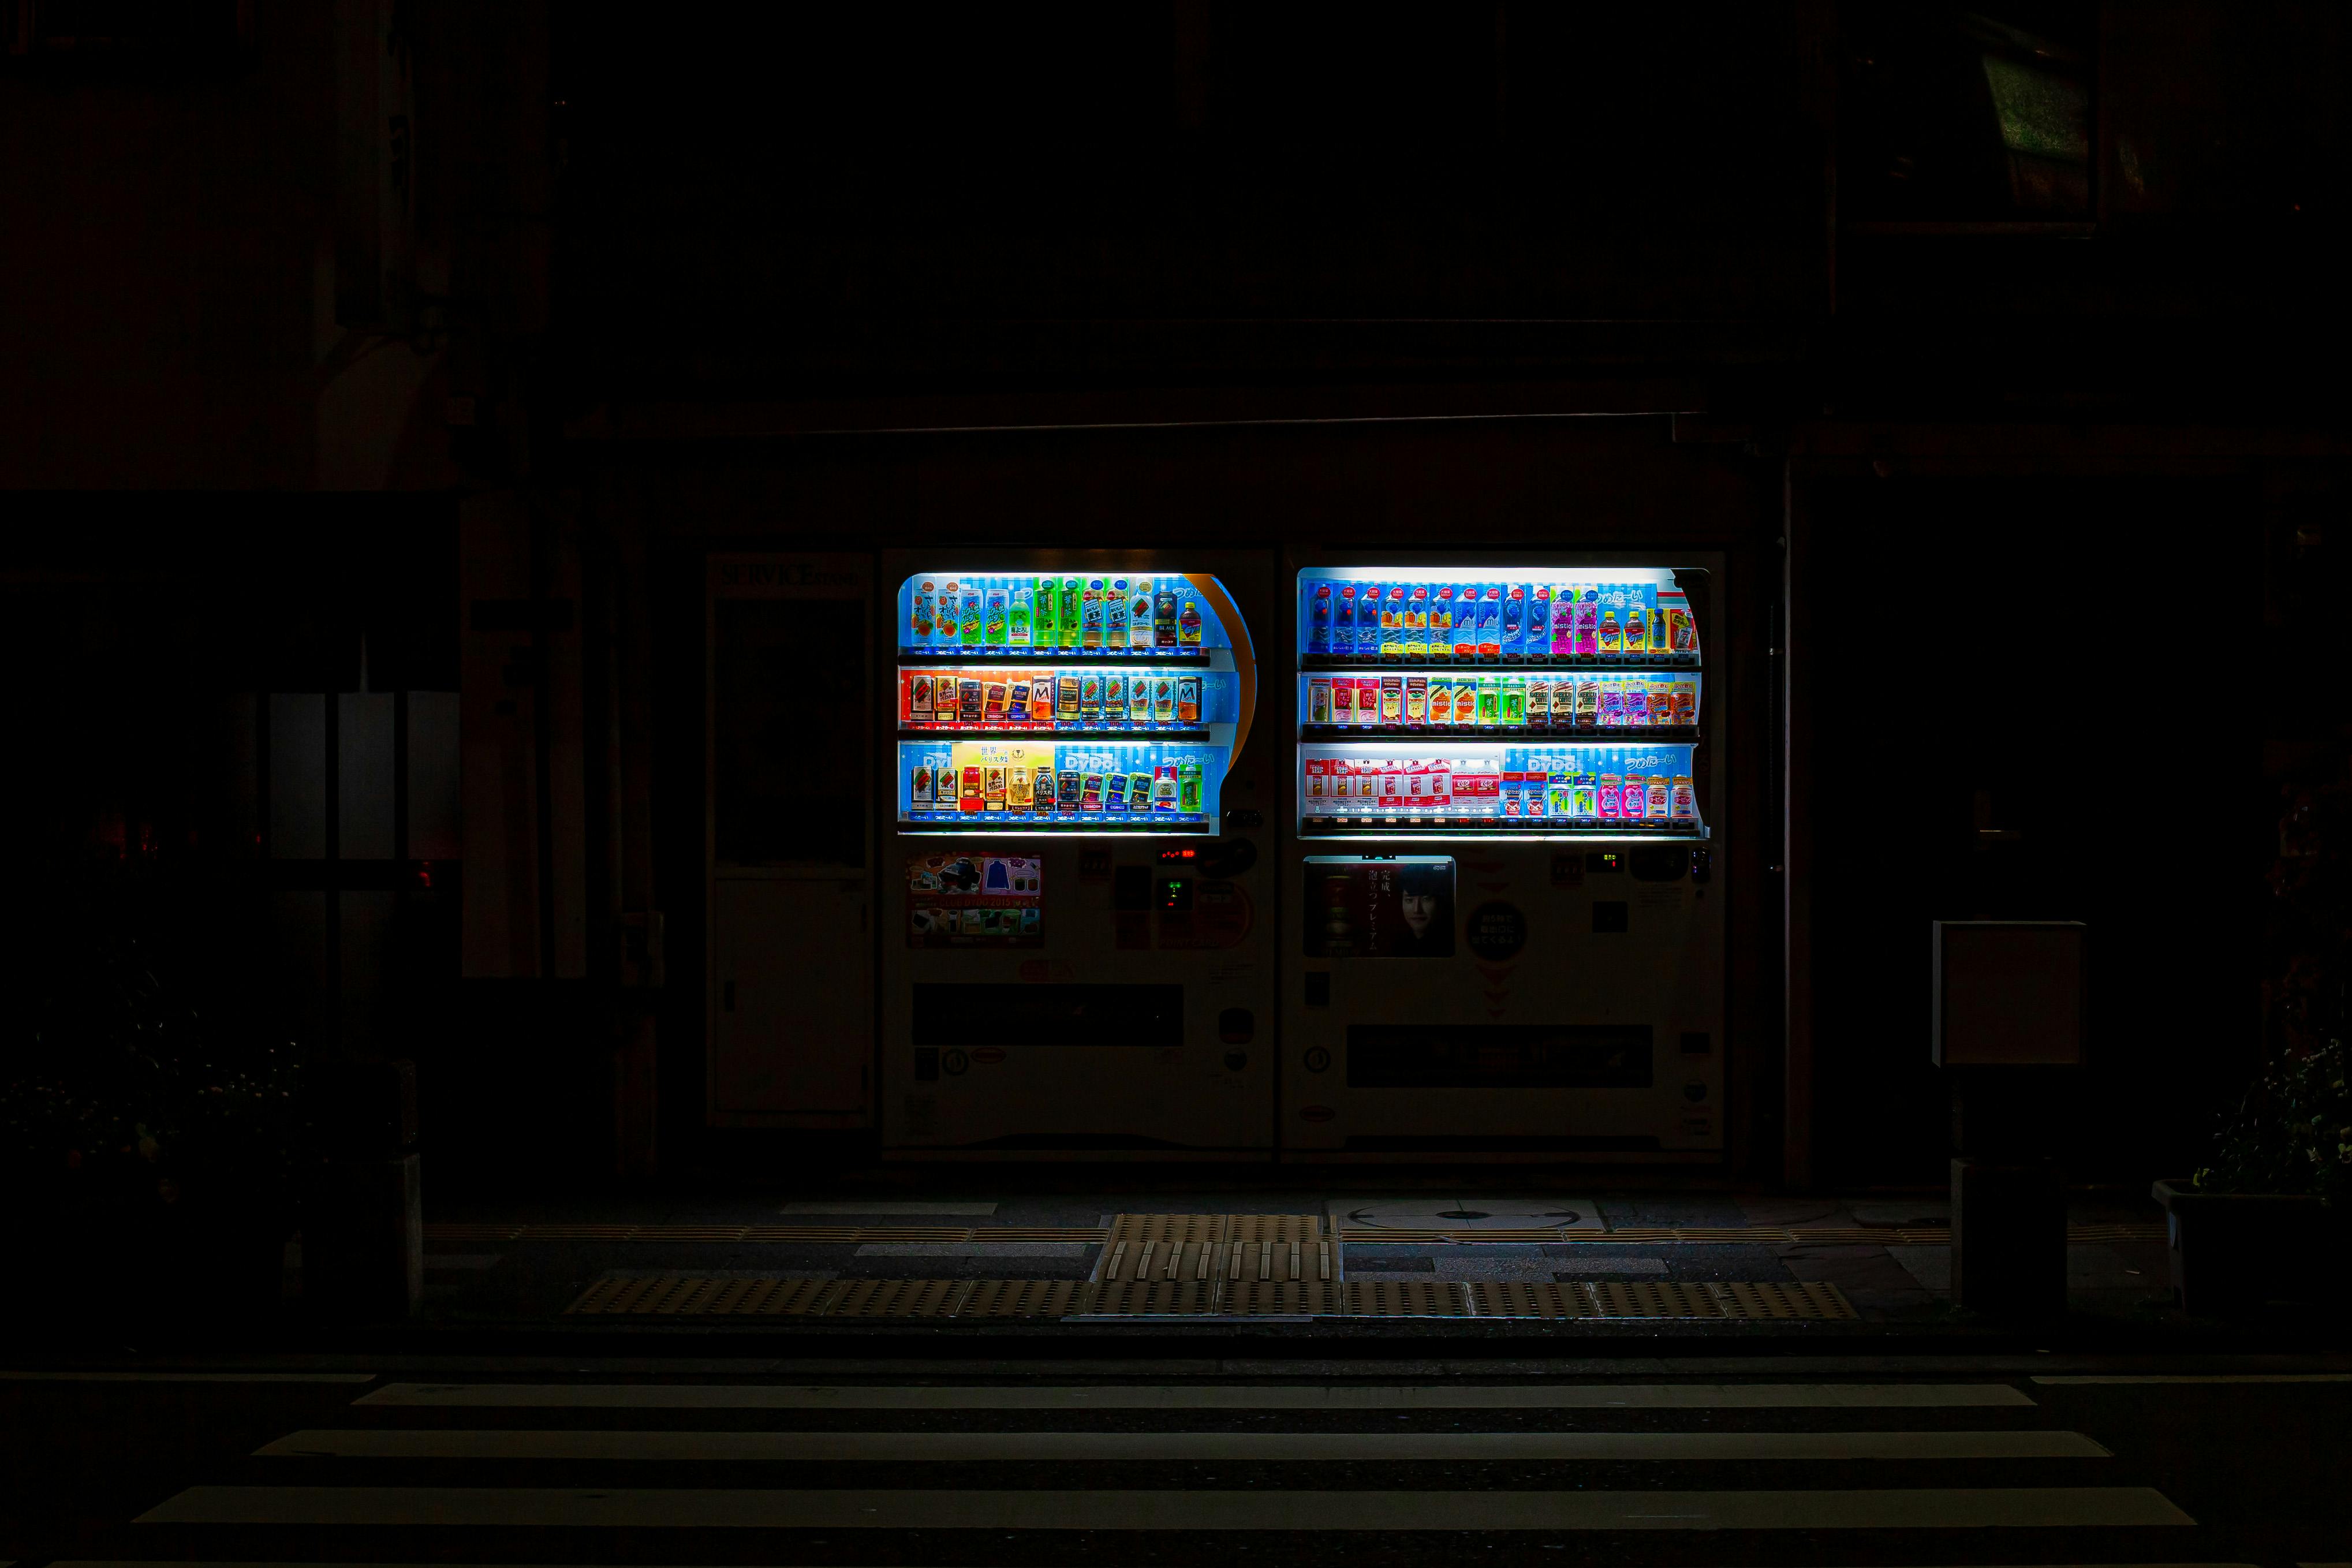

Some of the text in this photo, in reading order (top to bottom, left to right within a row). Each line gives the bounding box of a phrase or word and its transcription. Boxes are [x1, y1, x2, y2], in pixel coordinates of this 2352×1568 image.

[721, 564, 814, 585] SERVICE
[1034, 687, 1049, 702] M
[1179, 687, 1194, 702] M
[1065, 753, 1113, 771] DyDo
[1528, 756, 1575, 771] DyDo
[939, 897, 962, 906] CLUB
[965, 897, 988, 906] DYDO
[990, 897, 1010, 906] 2015
[1159, 938, 1190, 947] POINT
